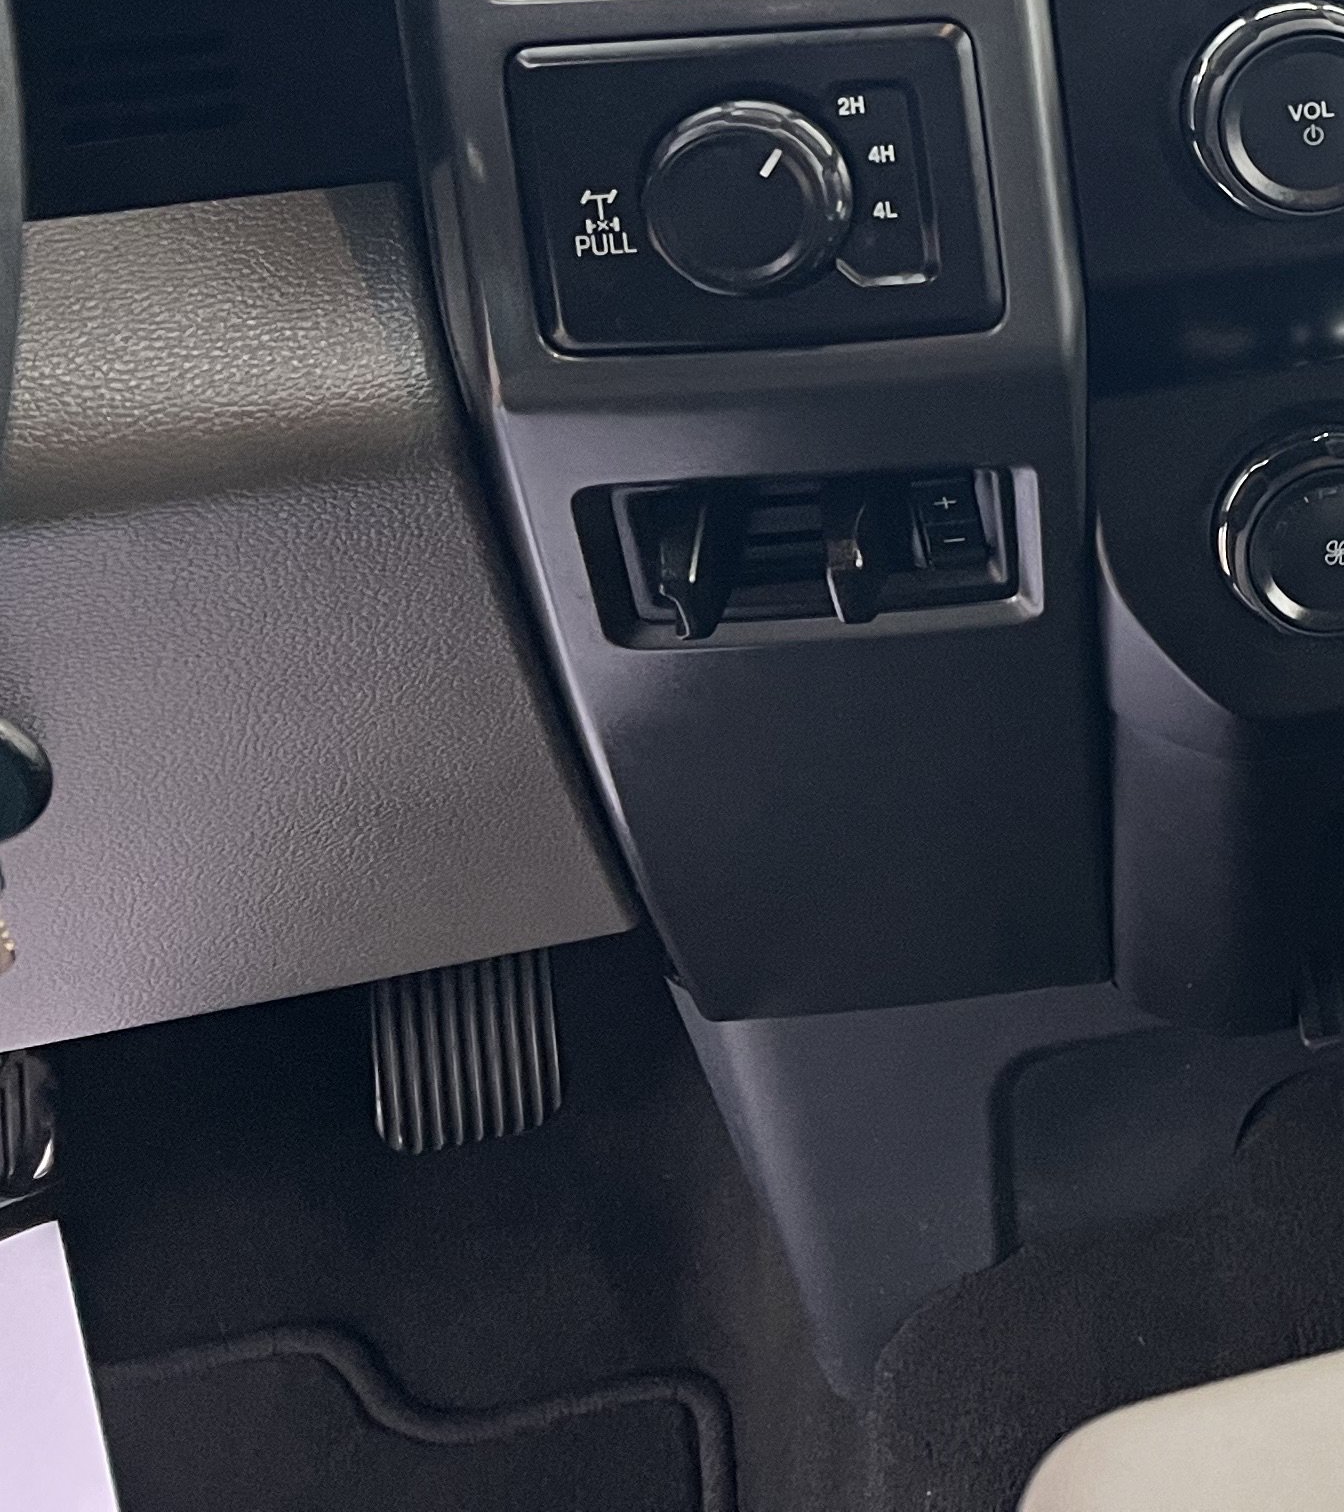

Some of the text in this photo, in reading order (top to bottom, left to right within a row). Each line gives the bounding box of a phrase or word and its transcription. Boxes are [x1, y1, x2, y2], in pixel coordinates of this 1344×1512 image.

[837, 95, 866, 116] 2H
[1287, 100, 1336, 123] VOL
[867, 144, 896, 164] 4H
[872, 201, 898, 220] 4L
[574, 232, 638, 258] PULL
